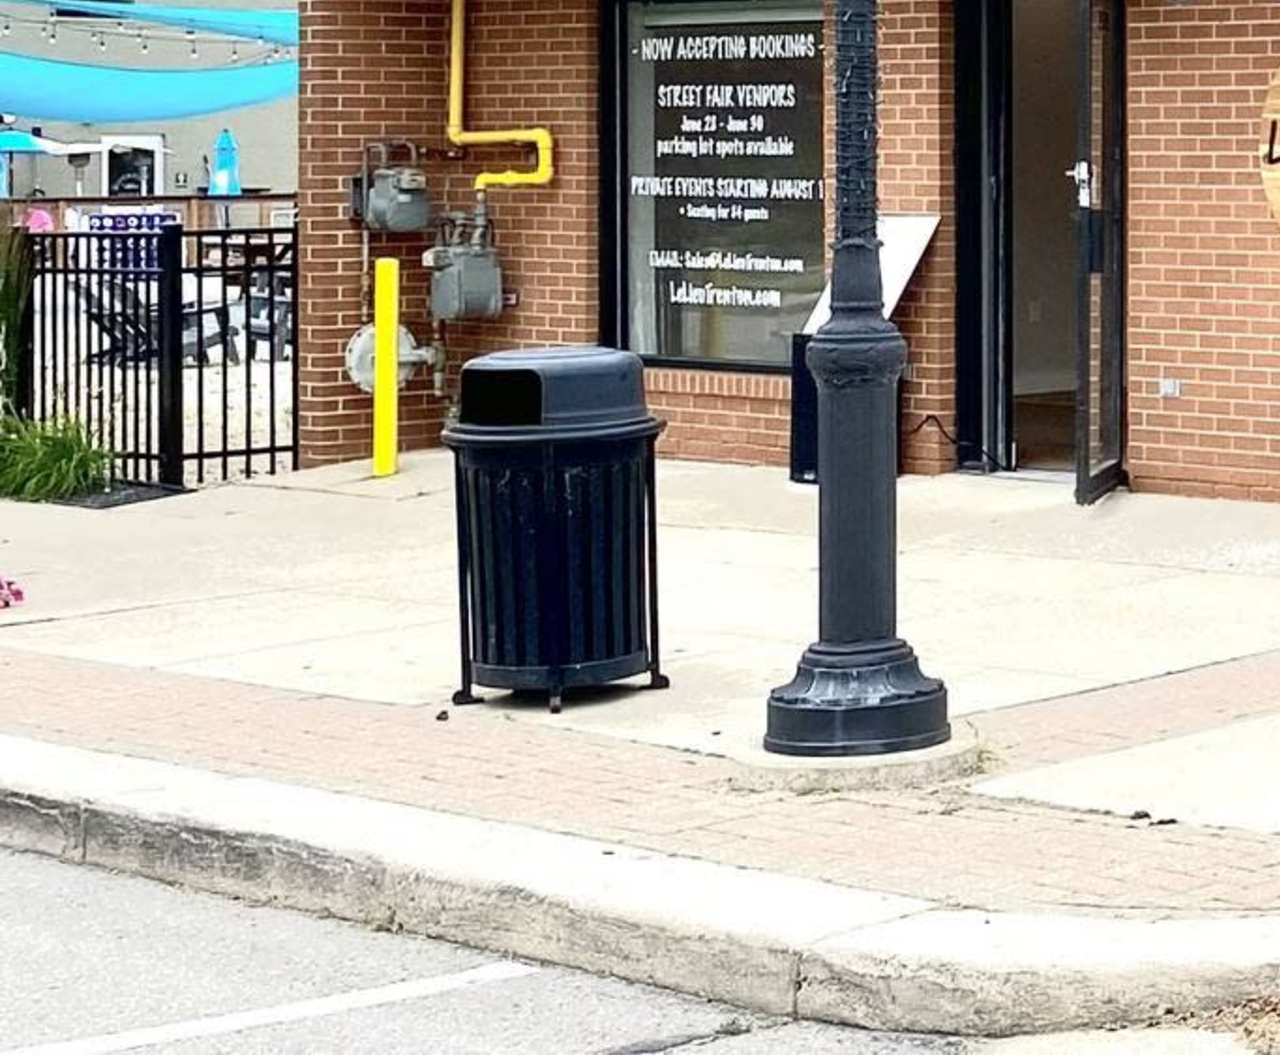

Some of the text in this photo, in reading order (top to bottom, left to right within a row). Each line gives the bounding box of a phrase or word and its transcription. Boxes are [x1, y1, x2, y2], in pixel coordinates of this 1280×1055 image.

[641, 37, 674, 61] NOW
[676, 35, 747, 60] ACCEPTING
[749, 34, 815, 59] BOOKINGS
[657, 84, 796, 107] STREET FAIR VENDORS
[680, 114, 702, 132] June
[726, 115, 748, 132] June
[657, 135, 794, 159] parking lot spots available
[631, 176, 673, 196] PRIVATE
[674, 177, 715, 197] EVENTS
[716, 177, 769, 198] STARTING
[770, 179, 815, 199] AUGUST
[686, 203, 716, 220] Seating
[717, 204, 730, 219] for
[744, 205, 769, 222] guests
[649, 250, 684, 268] EMAIL:
